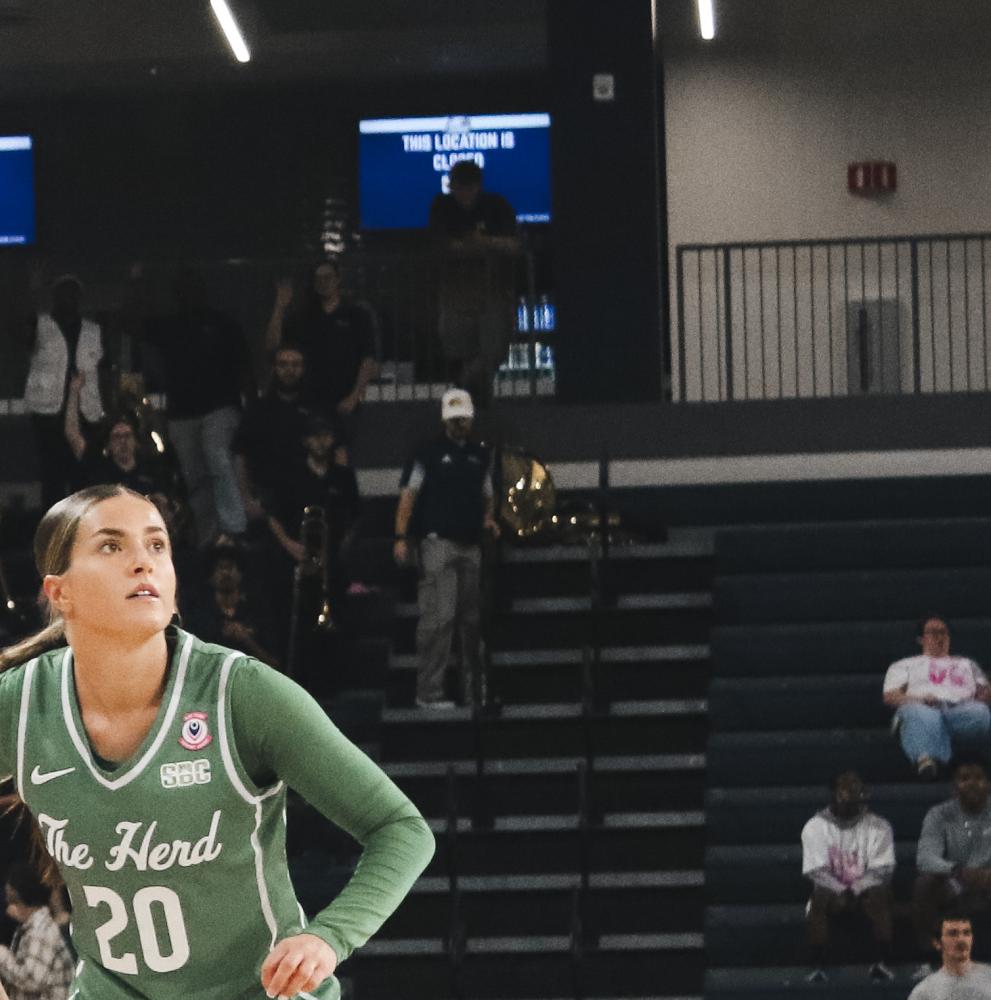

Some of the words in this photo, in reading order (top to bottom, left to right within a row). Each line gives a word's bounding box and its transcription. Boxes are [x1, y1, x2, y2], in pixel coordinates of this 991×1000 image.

[402, 134, 432, 152] THIS
[434, 132, 498, 151] LOCATION
[500, 131, 515, 149] IS
[38, 813, 94, 870] The
[105, 810, 223, 871] Herd
[83, 885, 191, 975] 20
